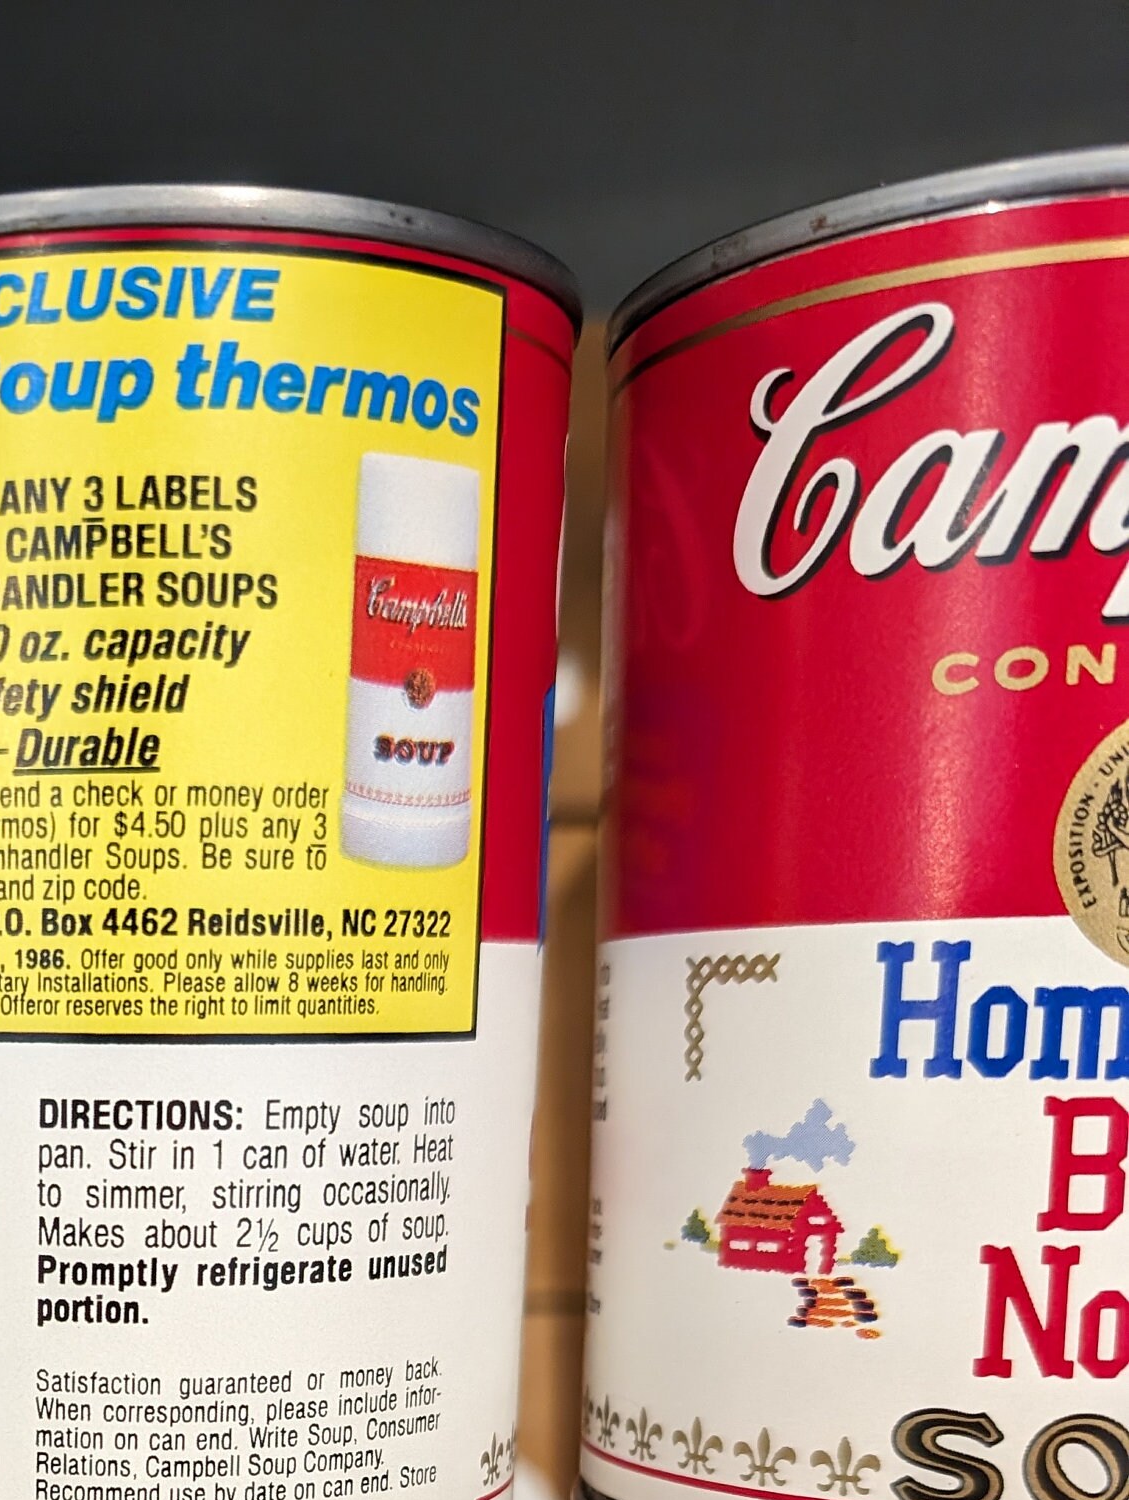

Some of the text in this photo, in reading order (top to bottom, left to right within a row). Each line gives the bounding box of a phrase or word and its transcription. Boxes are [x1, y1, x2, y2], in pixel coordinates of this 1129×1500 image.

[176, 341, 480, 437] thermos
[0, 476, 71, 516] ANY
[84, 476, 104, 512] 3
[116, 475, 258, 512] LABELS
[6, 523, 232, 563] CAMPBELL'S
[157, 572, 278, 609] SOUPS
[20, 632, 70, 667] oz.
[83, 622, 250, 669] capacity
[931, 642, 1116, 696] CON
[70, 668, 189, 715] shield
[13, 725, 161, 769] Durable
[374, 736, 455, 765] SOUP
[50, 787, 62, 806] a
[73, 780, 143, 807] check
[155, 785, 177, 806] or
[187, 785, 263, 812] money
[273, 782, 329, 809] order
[69, 812, 100, 838] for
[114, 811, 185, 839] $4.50
[200, 812, 248, 843] plus
[262, 816, 300, 843] any
[313, 813, 327, 840] 3
[1069, 794, 1096, 909] EXPOSITION
[42, 875, 75, 905] zip
[84, 873, 147, 900] code.
[42, 908, 93, 936] Box
[102, 908, 178, 936] 4462
[187, 908, 333, 941] Reidsville,
[341, 910, 376, 936] NC
[384, 910, 451, 937] 27322
[14, 949, 70, 970] 1986.
[870, 940, 1129, 1079] Hom
[39, 1096, 455, 1135] DIRECTIONS: Empty soup into
[38, 1134, 453, 1173] pan. Stir in 1 can of water. Heat
[1036, 1095, 1129, 1232] B
[38, 1172, 450, 1213] to simmer, stirring occasionally.
[38, 1216, 124, 1248] Makes
[145, 1219, 218, 1248] about
[297, 1220, 352, 1250] cups
[368, 1213, 389, 1241] of
[402, 1213, 449, 1240] soup.
[37, 1245, 448, 1292] Promptly refrigerate unused
[37, 1296, 148, 1327] portion.
[973, 1244, 1129, 1379] No
[36, 1356, 441, 1400] Satisfaction guaranteed or money back.
